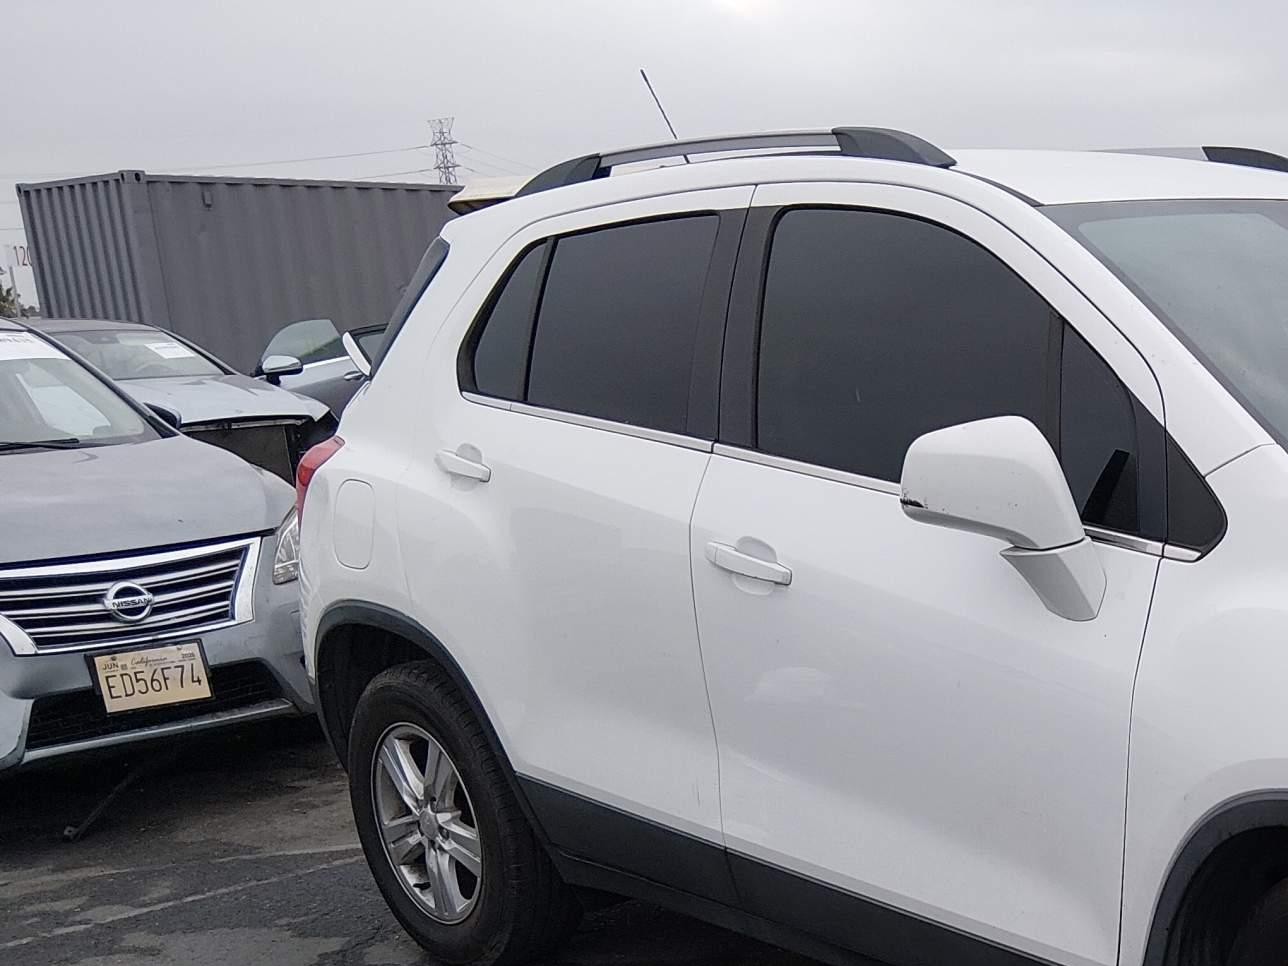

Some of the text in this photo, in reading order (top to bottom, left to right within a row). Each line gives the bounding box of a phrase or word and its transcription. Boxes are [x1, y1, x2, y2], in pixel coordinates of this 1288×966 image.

[112, 597, 151, 609] NISSAN
[103, 662, 119, 671] JUN
[105, 662, 202, 700] ED56F74
